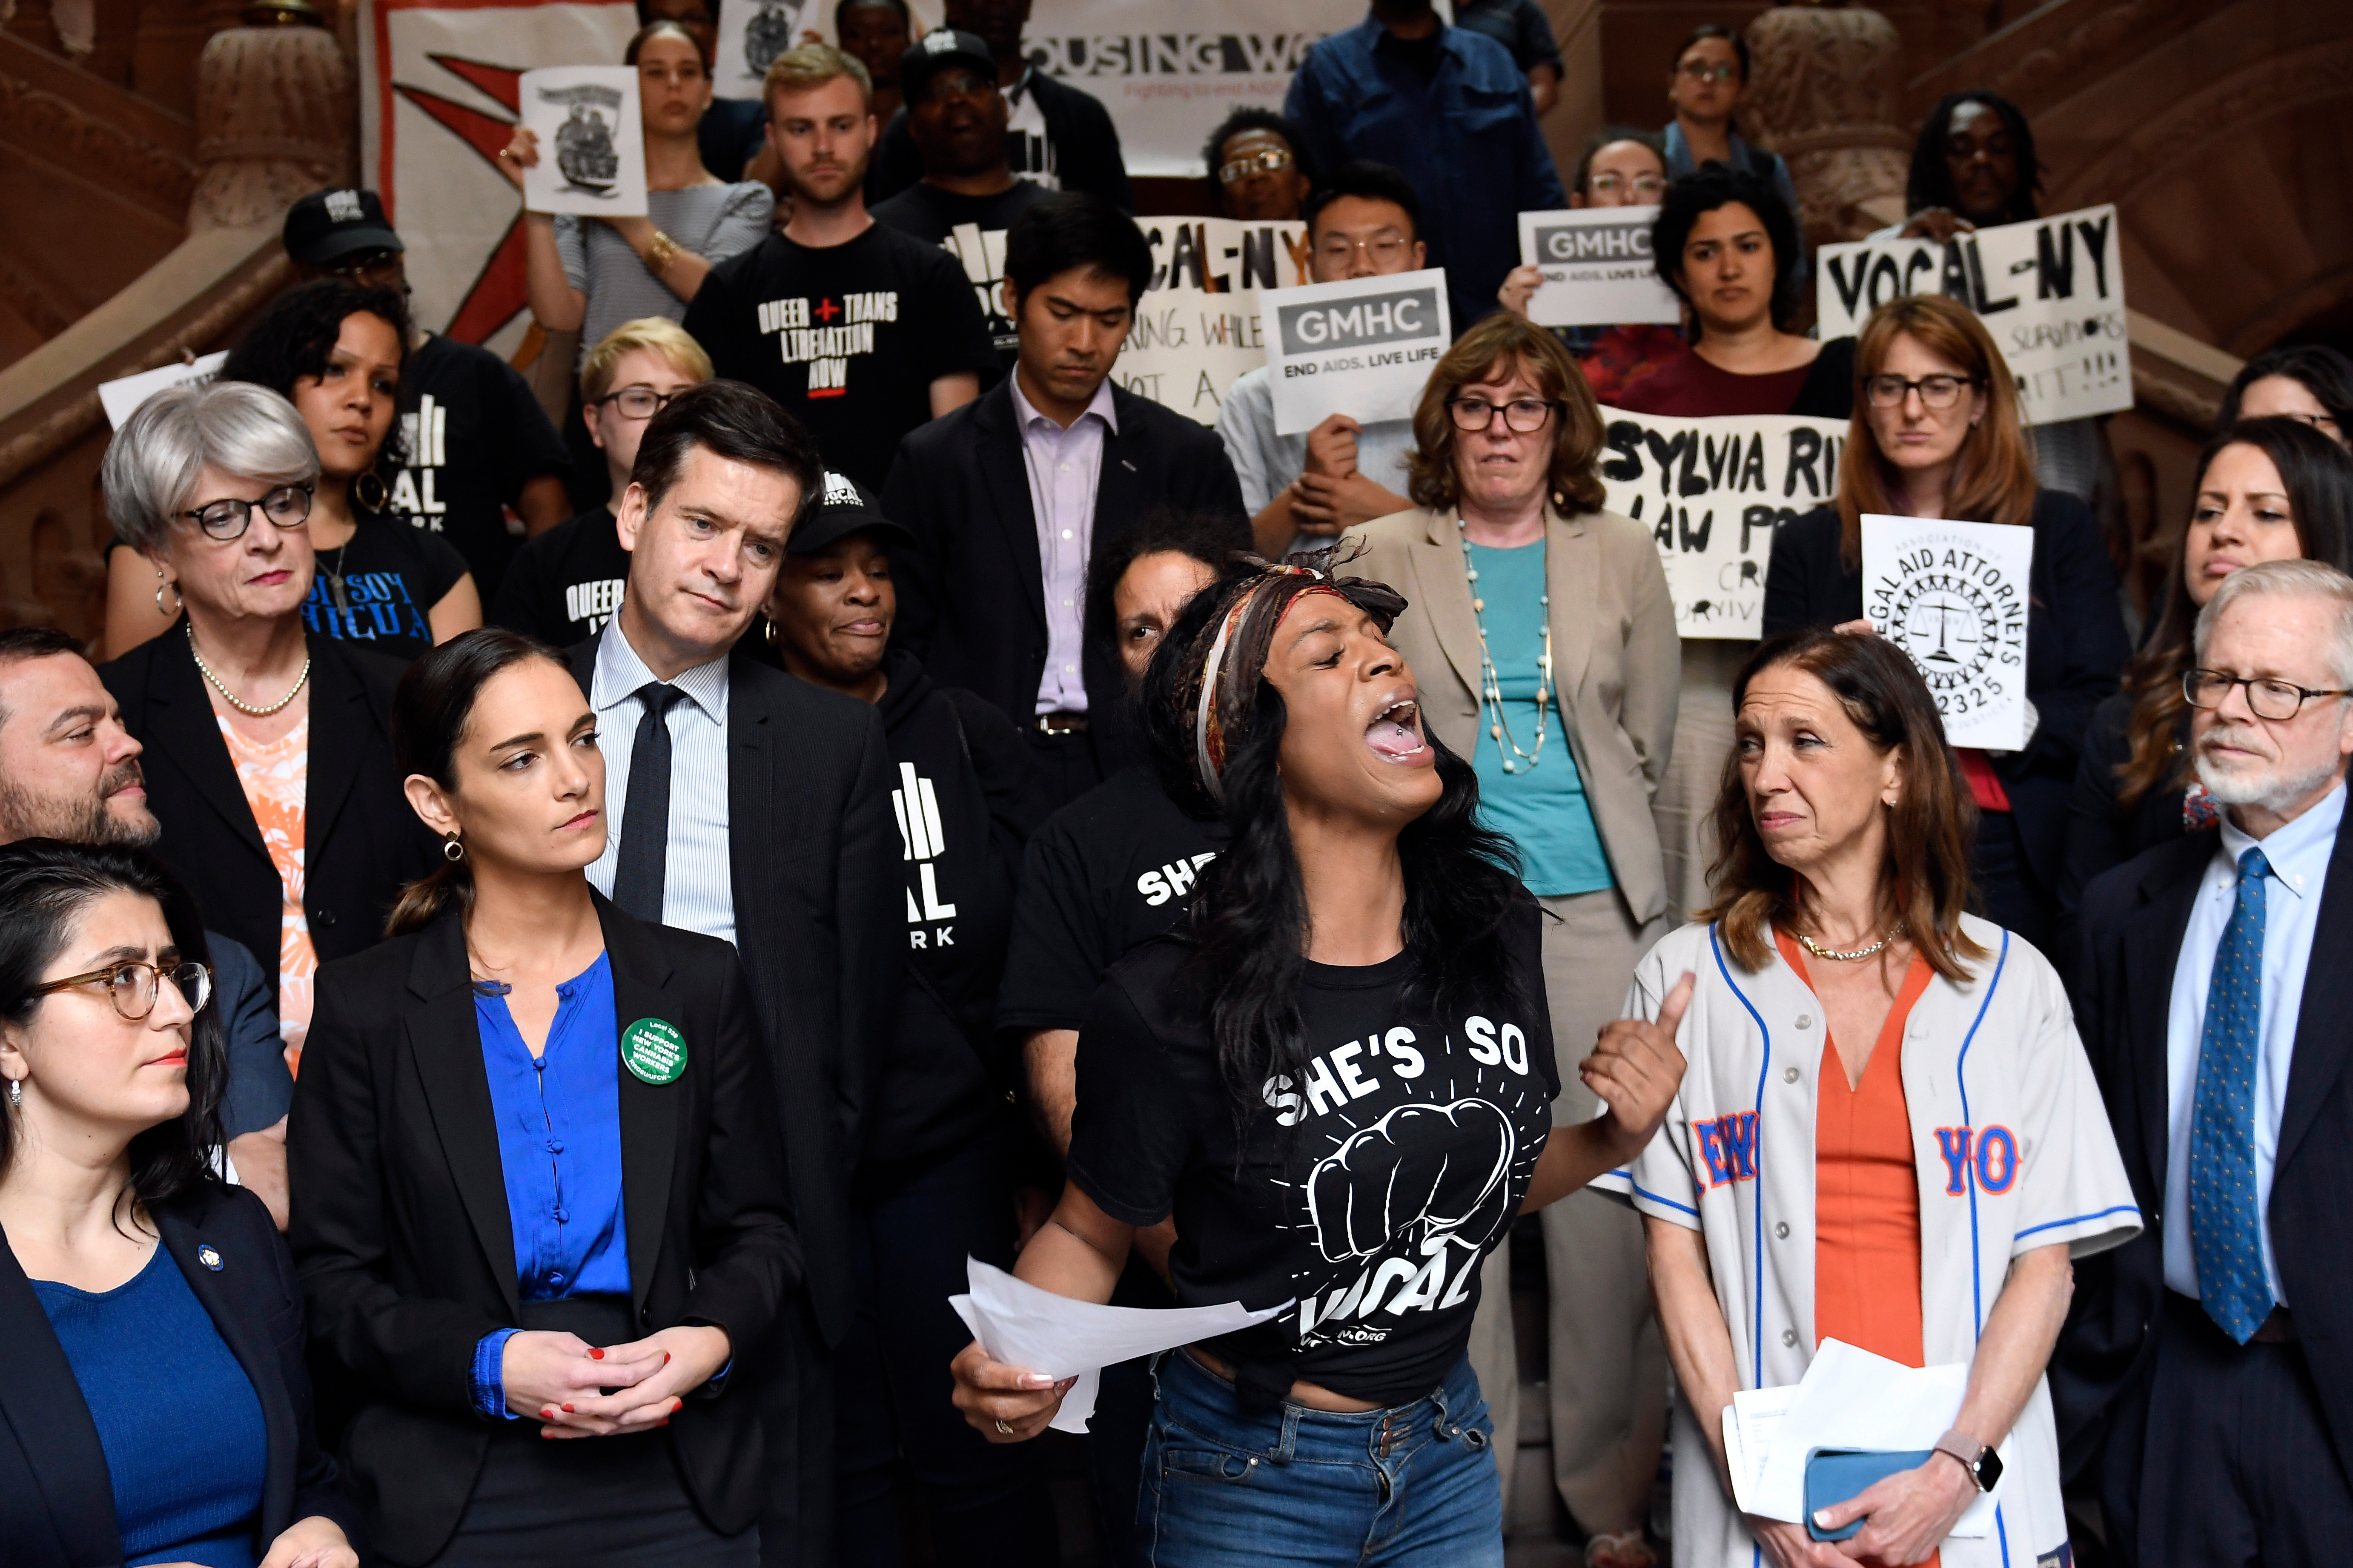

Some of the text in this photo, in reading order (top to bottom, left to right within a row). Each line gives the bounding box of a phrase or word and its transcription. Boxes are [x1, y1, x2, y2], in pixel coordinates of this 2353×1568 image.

[1548, 226, 1653, 259] GMHC
[1543, 271, 1566, 283] ND
[1827, 213, 2111, 318] VOCAL-NY
[757, 297, 810, 335] QUEER
[842, 291, 898, 325] TRANS
[1201, 312, 1265, 349] WHILE
[1296, 298, 1423, 344] GMHC
[780, 321, 874, 364] LIBERATION
[808, 357, 848, 390] NOW
[1284, 362, 1318, 378] END
[1323, 357, 1365, 373] AIDS.
[1369, 350, 1404, 367] LIVE
[1602, 420, 1767, 499] SYLVIA
[346, 572, 413, 604] SOY
[566, 578, 625, 623] QUEER
[1898, 548, 1934, 578] AID
[1942, 548, 2024, 667] ATTORNEYS
[1937, 676, 2004, 716] 2325
[907, 863, 957, 923] L
[644, 1031, 680, 1052] SUPPORT
[650, 1021, 668, 1031] Local
[633, 1034, 680, 1062] NEW YORK'S
[633, 1043, 674, 1067] CANNABIS
[633, 1050, 670, 1074] WORKERS
[628, 1058, 668, 1081] RWDSU/UFCW
[1262, 1015, 1529, 1127] SHE'S SO
[1690, 1109, 2023, 1197] EW YO
